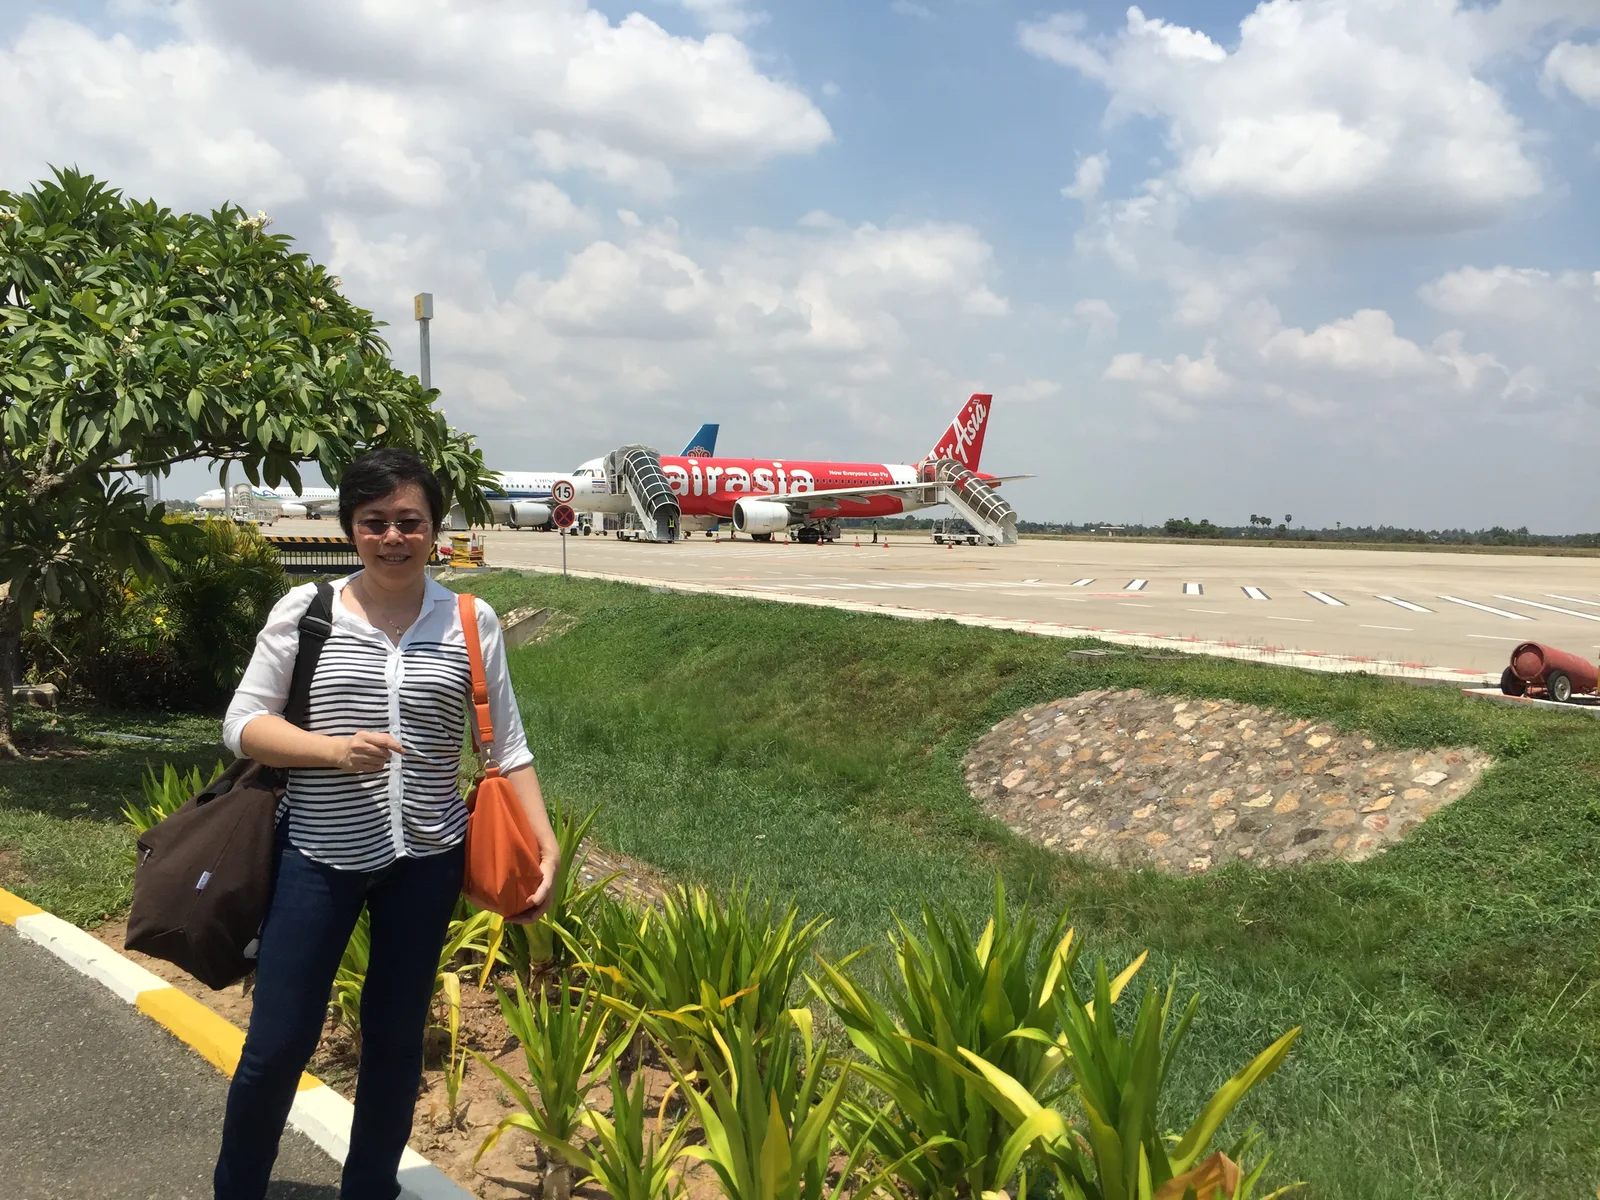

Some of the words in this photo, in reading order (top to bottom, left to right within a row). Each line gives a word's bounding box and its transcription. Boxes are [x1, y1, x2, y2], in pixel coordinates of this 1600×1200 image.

[953, 403, 986, 464] Asia
[556, 486, 571, 499] 15
[662, 459, 815, 496] airasia
